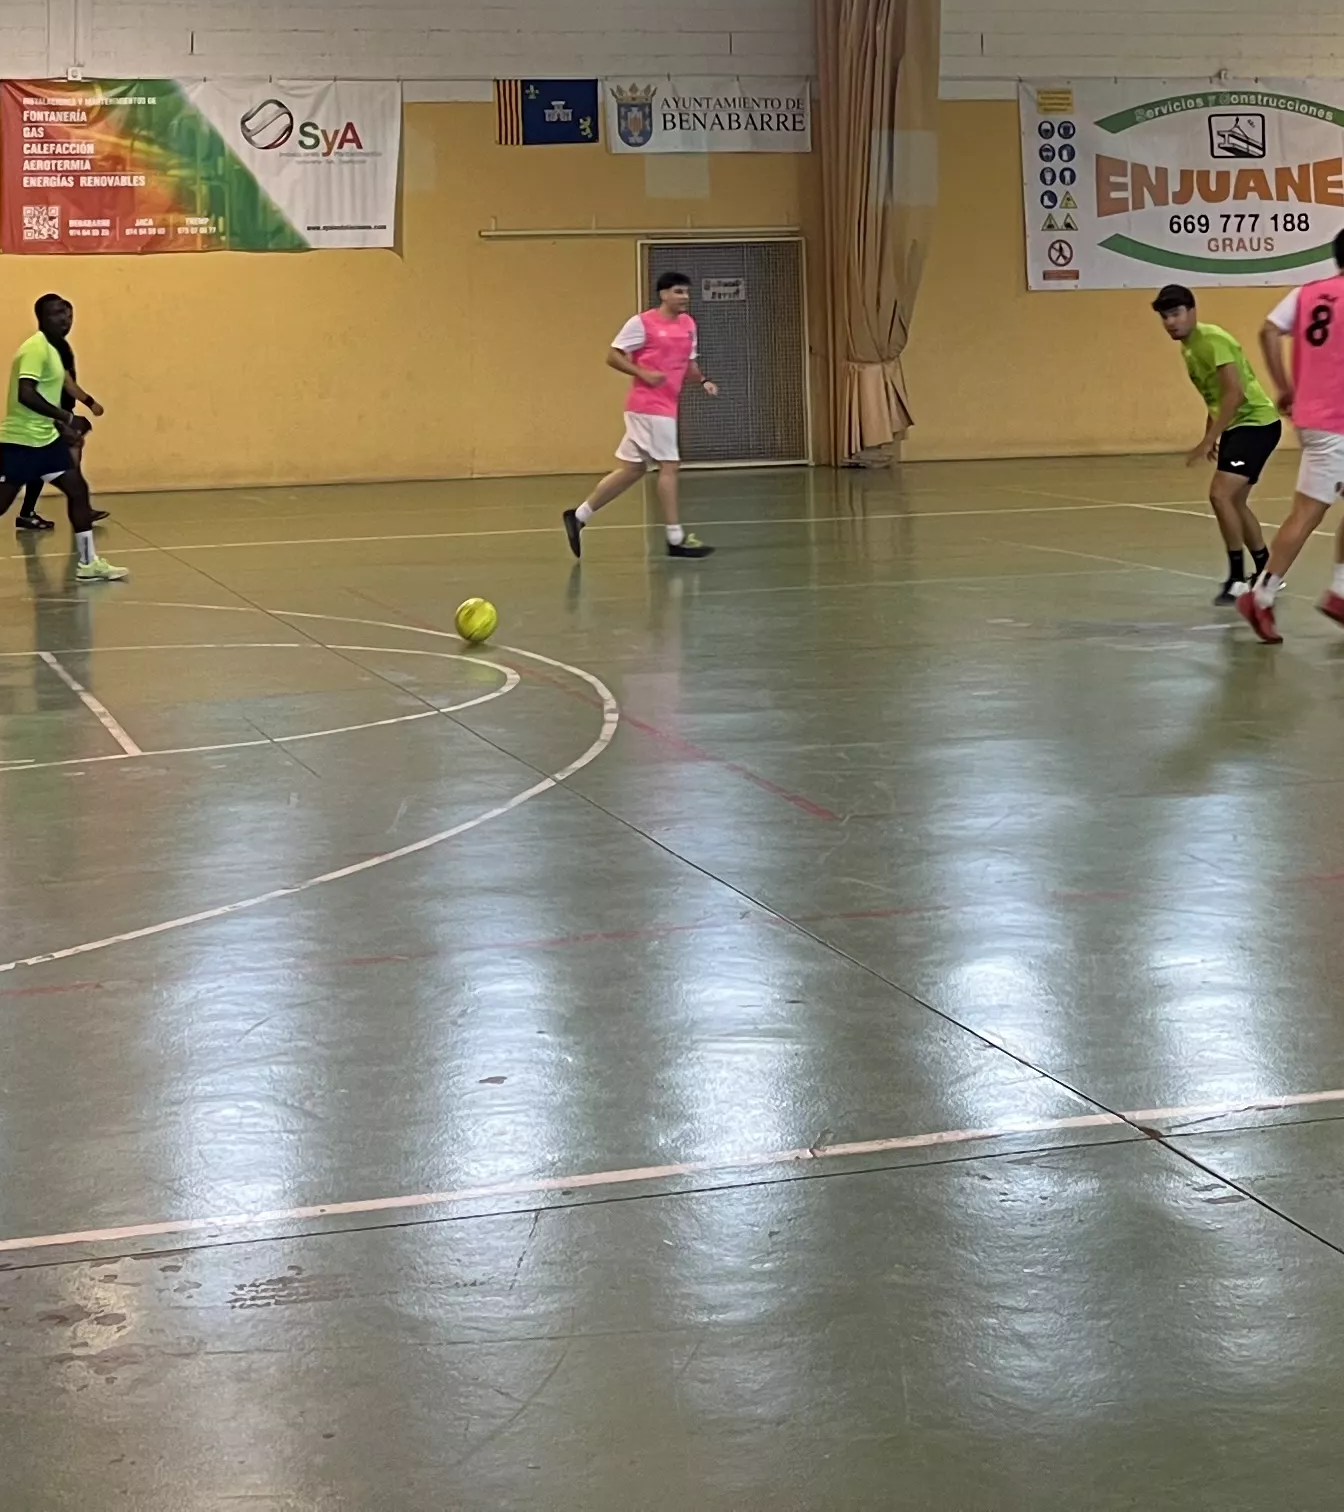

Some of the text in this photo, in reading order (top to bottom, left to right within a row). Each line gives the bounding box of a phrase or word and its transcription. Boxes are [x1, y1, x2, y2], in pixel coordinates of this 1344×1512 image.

[660, 96, 805, 110] AYUNTAMIENTO DE
[1134, 97, 1204, 122] Servicios
[1219, 92, 1334, 122] Construcciones
[22, 108, 88, 122] FONTANERÍA
[662, 112, 806, 132] BENABARRE
[22, 126, 45, 138] GAS
[298, 121, 364, 158] SyA
[22, 141, 95, 155] CALEFACCIÓN
[22, 159, 92, 171] AEROTERMIA
[22, 174, 146, 188] ENERGÍAS RENOVABLES
[1169, 212, 1310, 234] 669 777 188
[1207, 237, 1275, 253] GRAUS
[1305, 304, 1333, 347] 8
